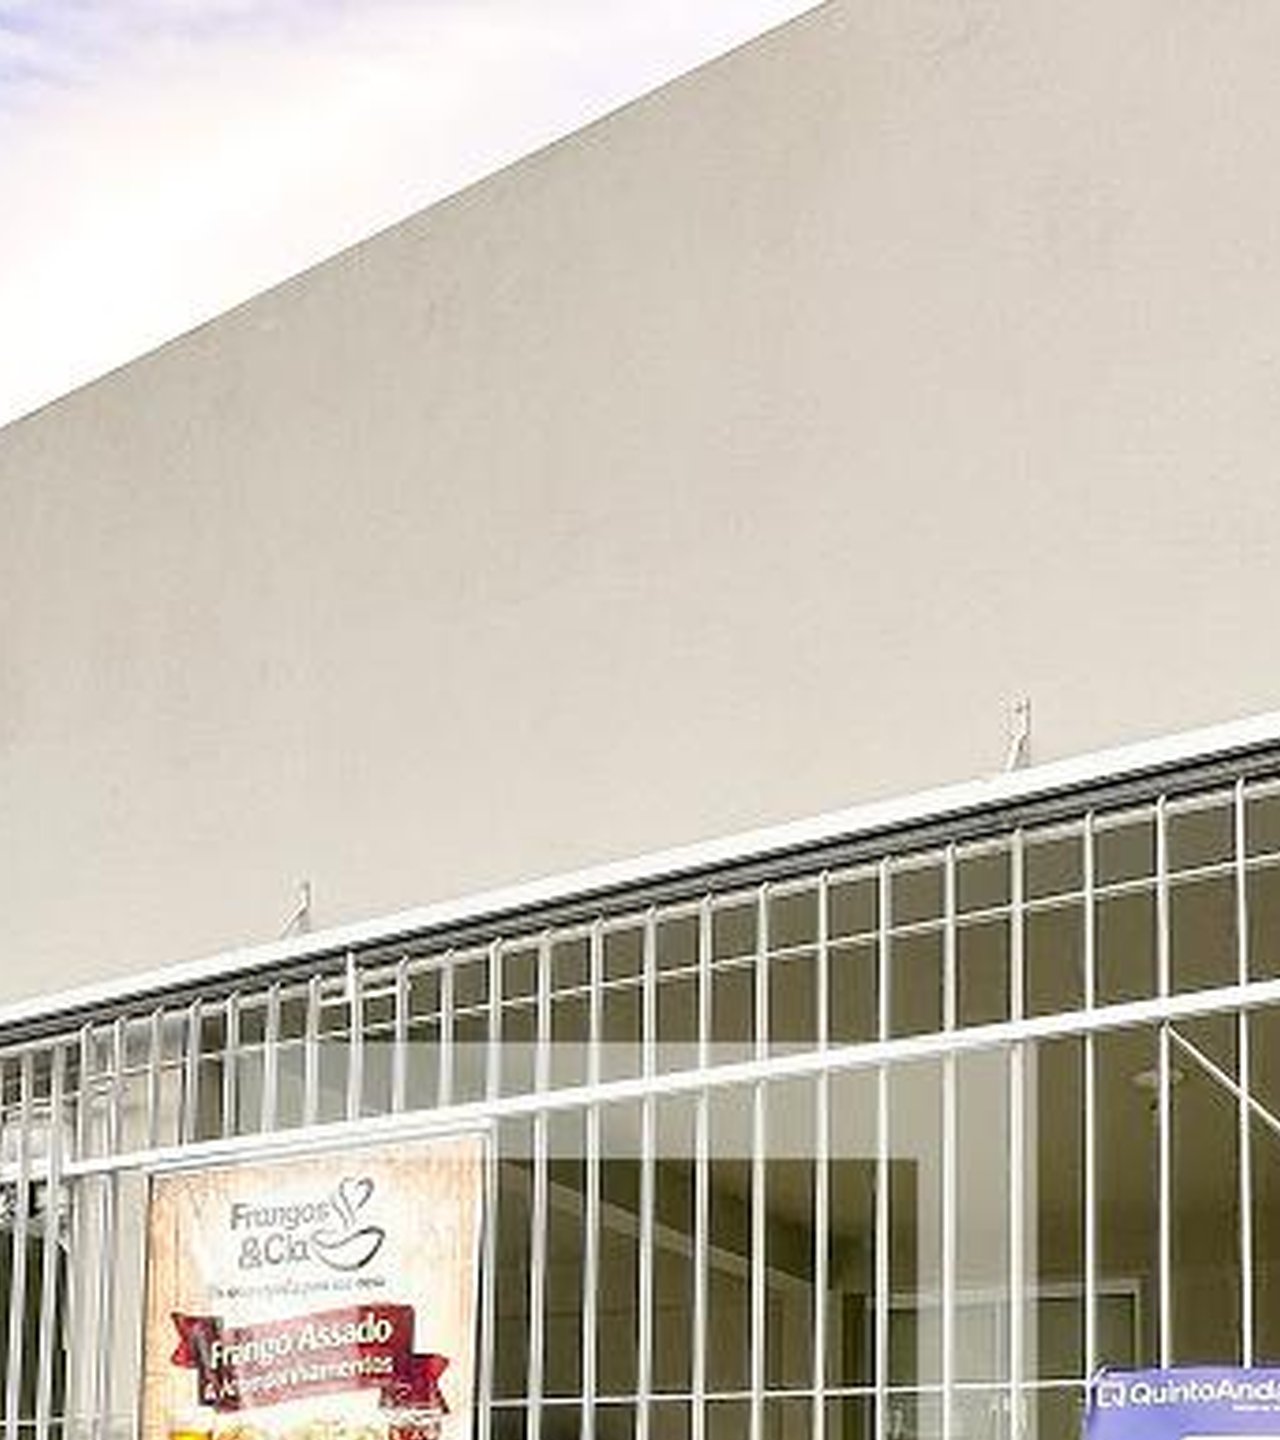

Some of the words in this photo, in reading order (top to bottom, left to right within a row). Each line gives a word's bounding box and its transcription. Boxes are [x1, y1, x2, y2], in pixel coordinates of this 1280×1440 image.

[230, 1202, 329, 1231] Frangos
[211, 1339, 291, 1369] Frango
[298, 1313, 393, 1352] Assado
